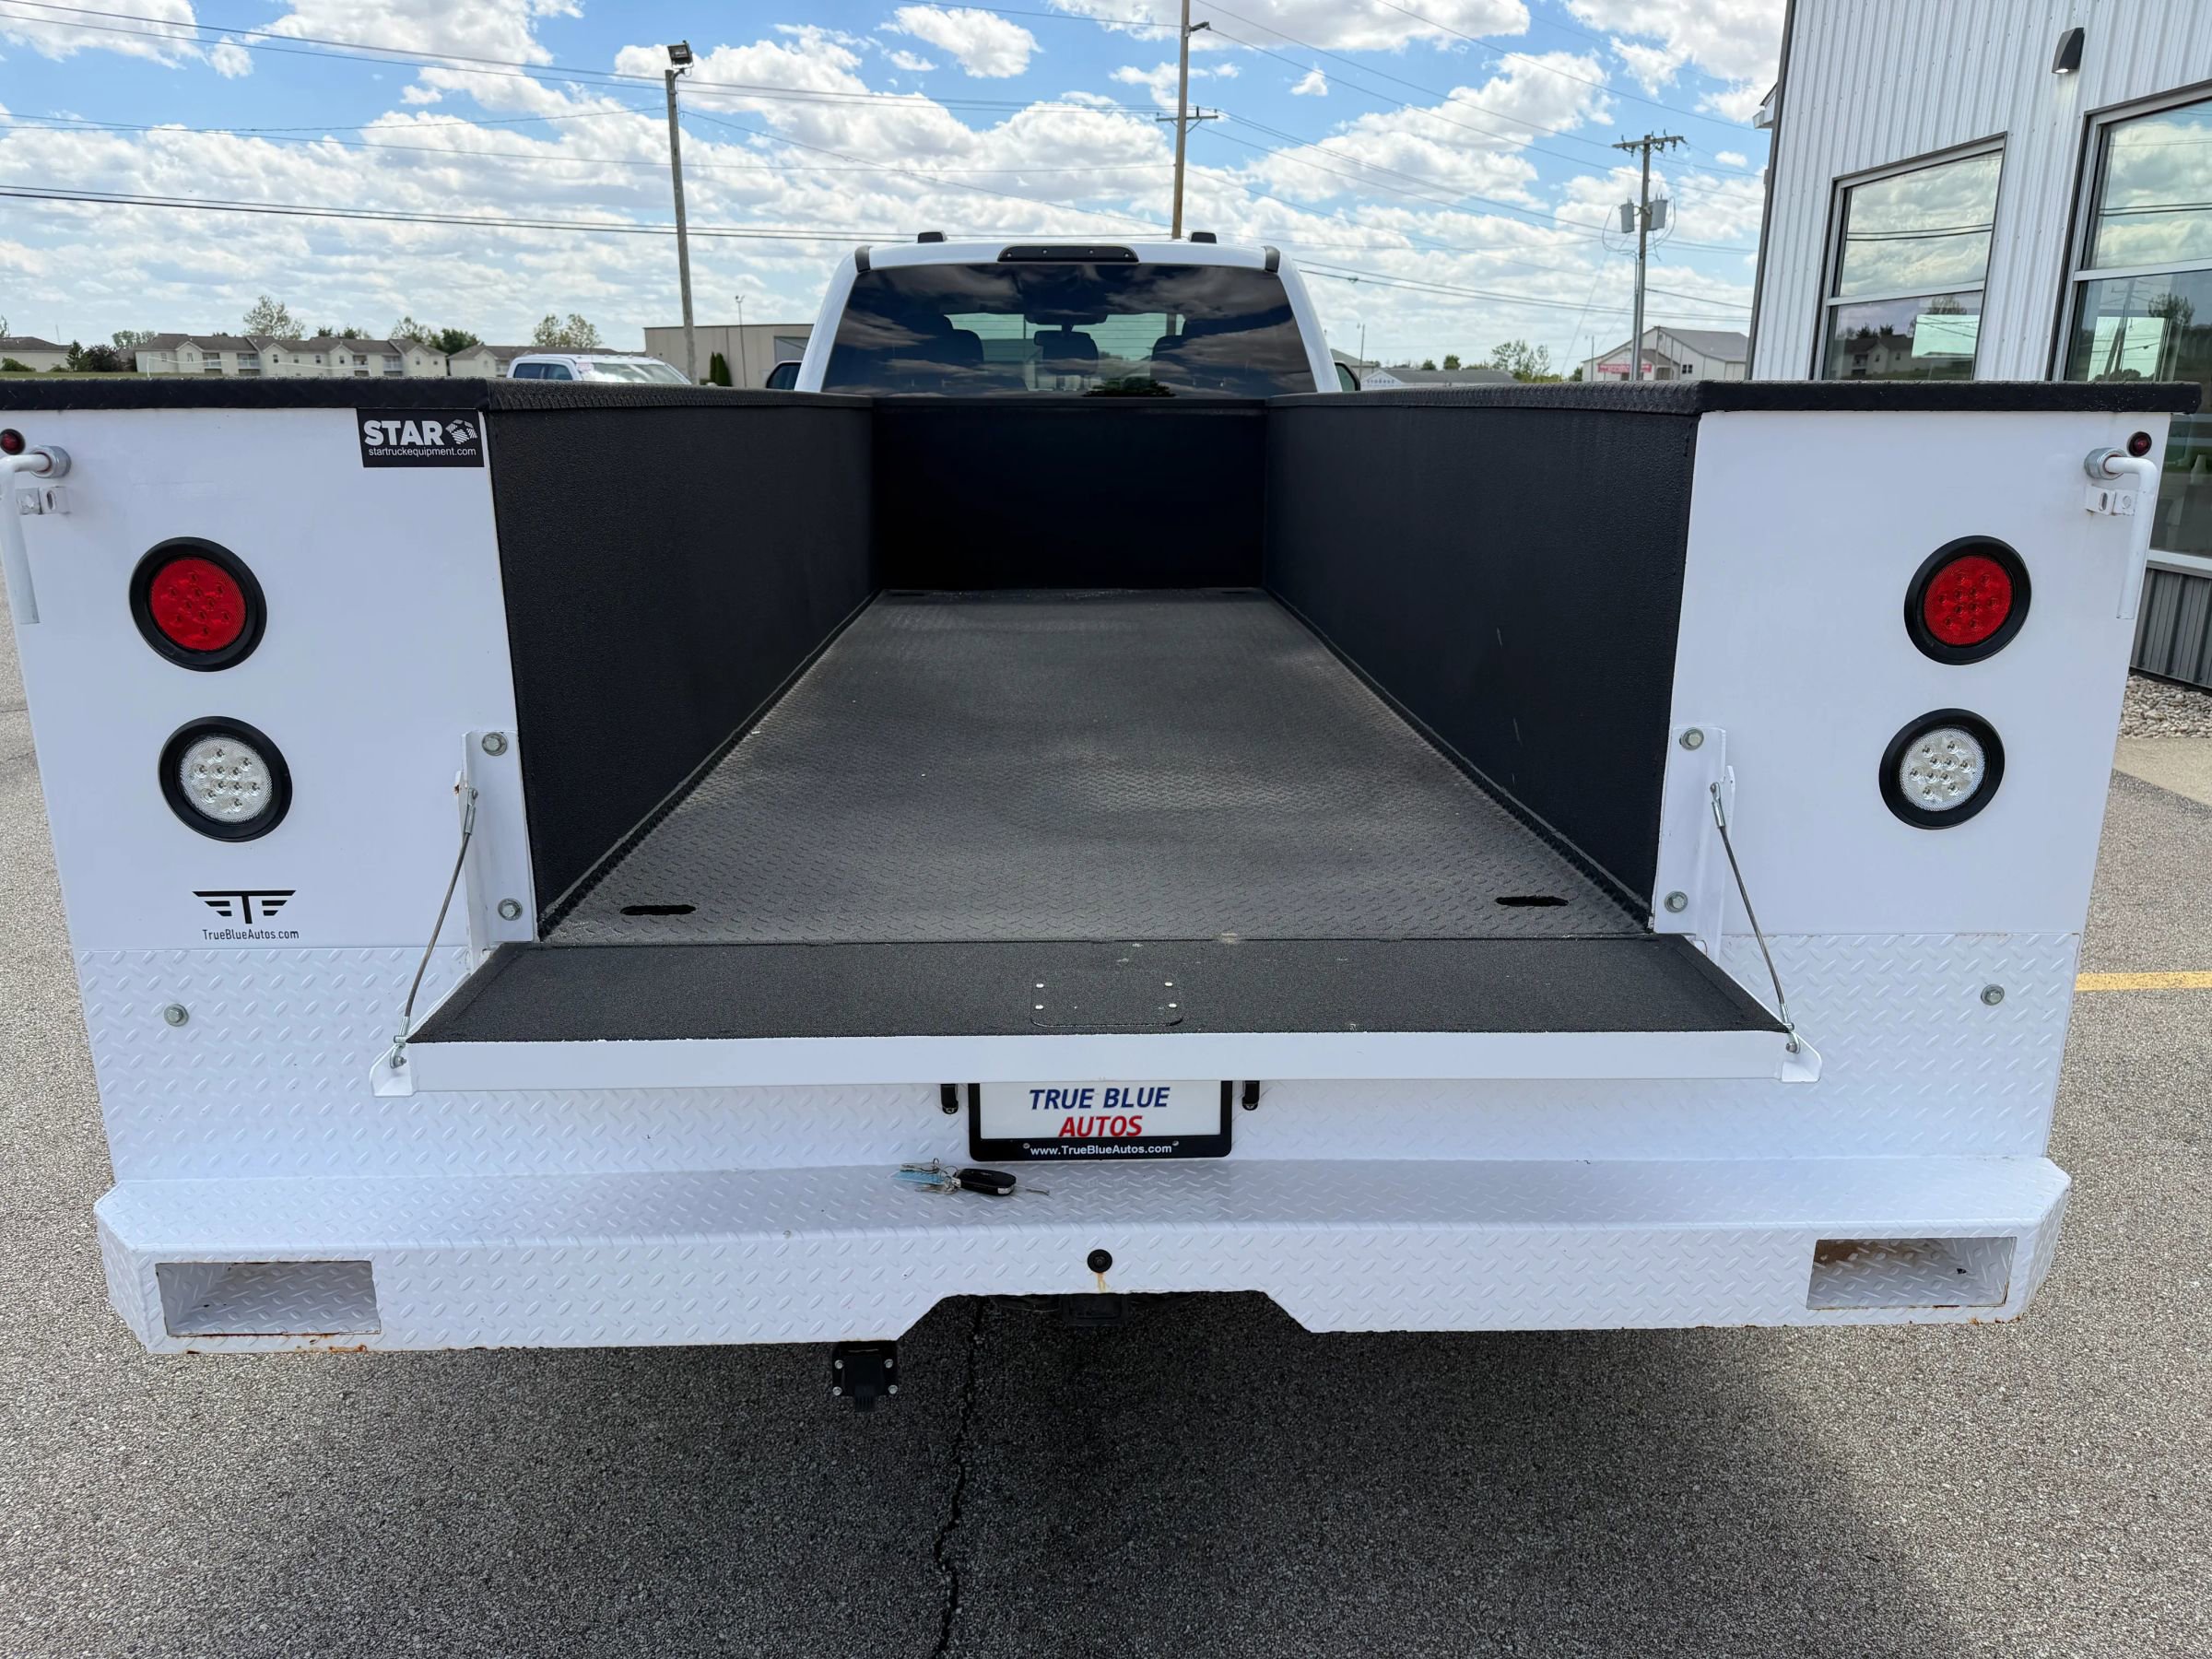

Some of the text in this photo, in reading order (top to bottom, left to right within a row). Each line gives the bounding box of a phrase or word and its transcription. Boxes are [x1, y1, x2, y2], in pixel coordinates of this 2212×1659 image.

[363, 419, 444, 446] STAR
[369, 447, 476, 457] startruckequipment.com
[202, 929, 300, 940] TrueBlueAutos.com
[1030, 1087, 1171, 1110] TRUE BLUE
[1058, 1115, 1143, 1137] AUTOS
[1030, 1144, 1172, 1157] www.TrueBlueAutos.com
